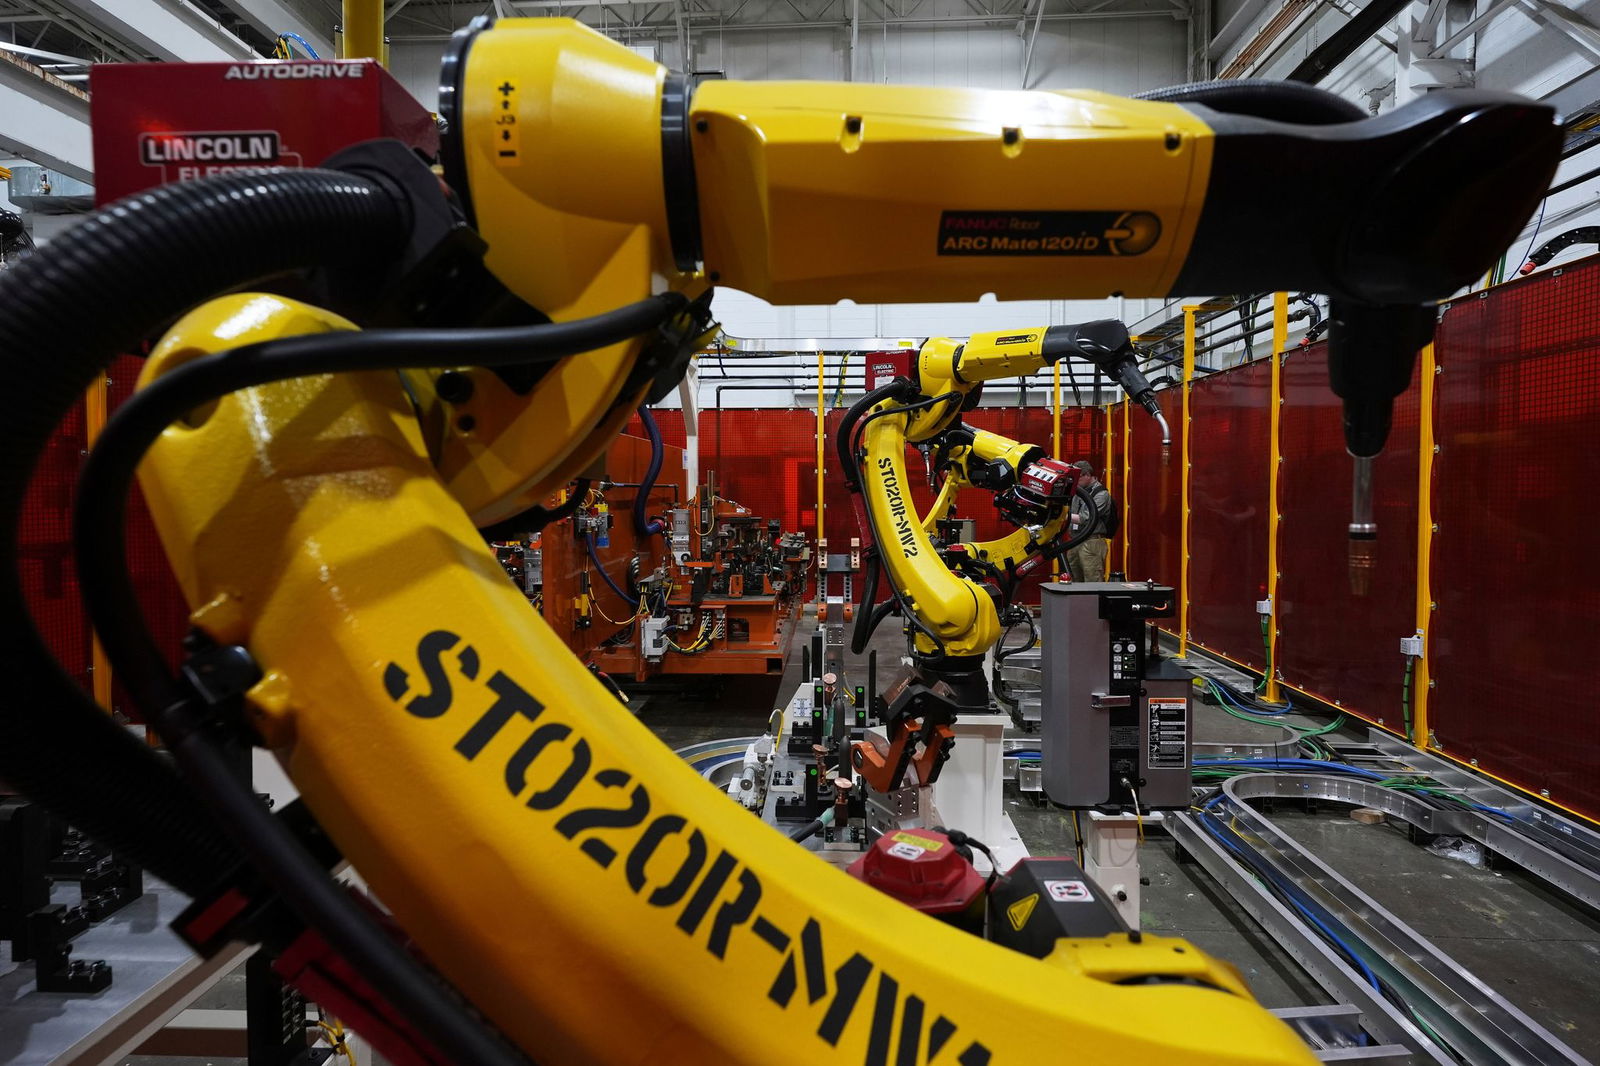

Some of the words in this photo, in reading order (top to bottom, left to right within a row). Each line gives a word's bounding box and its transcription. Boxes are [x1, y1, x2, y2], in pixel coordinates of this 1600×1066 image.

[225, 64, 363, 79] AUTODRIVE
[148, 137, 271, 160] LINCOLN
[945, 217, 1007, 230] FANUC
[944, 237, 988, 250] ARC
[383, 629, 992, 1066] ST020R-MW
